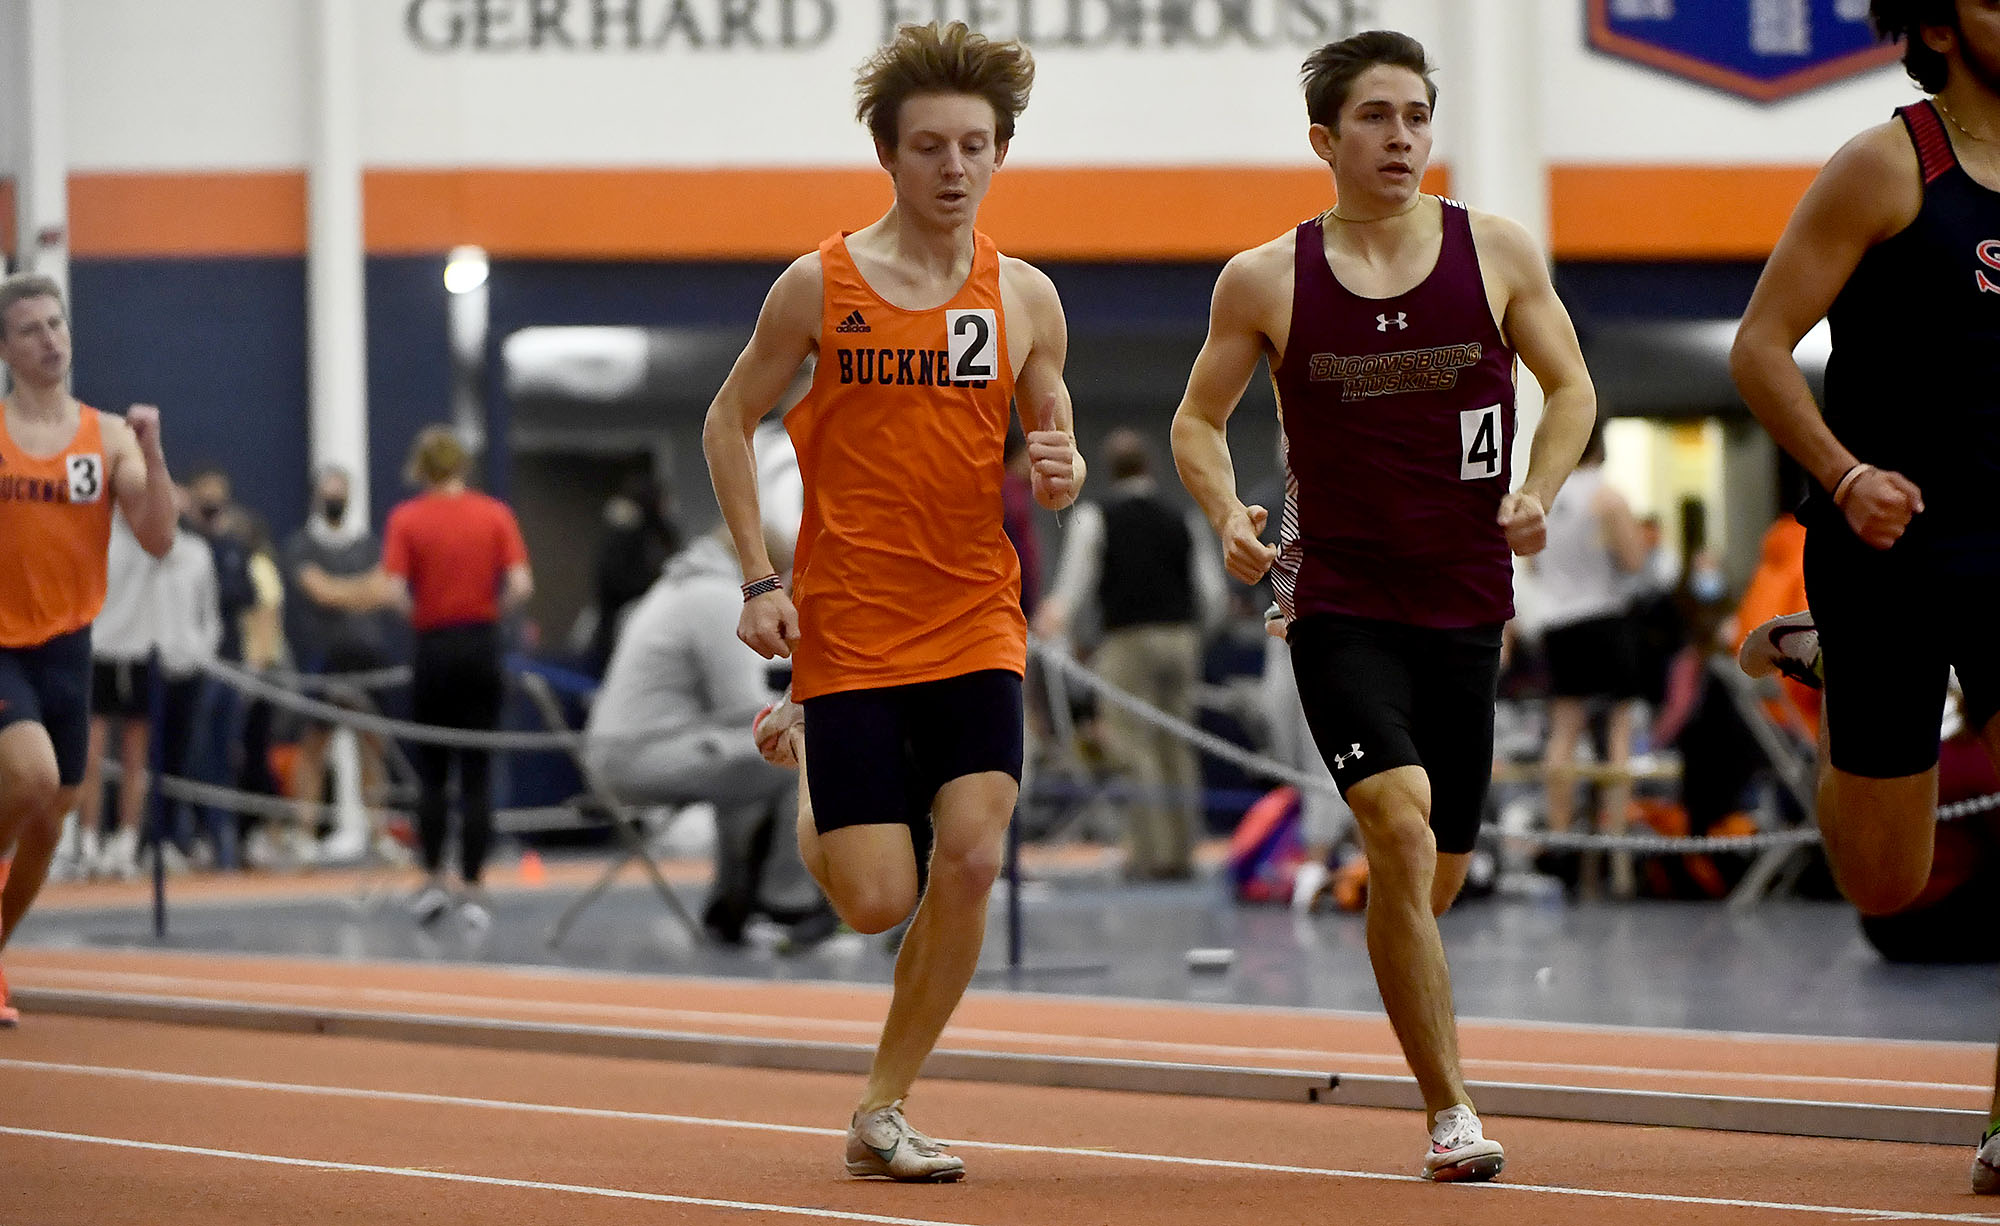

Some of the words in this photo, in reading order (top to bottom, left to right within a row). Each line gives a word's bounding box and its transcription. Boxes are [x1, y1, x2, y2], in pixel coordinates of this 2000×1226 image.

[405, 0, 836, 53] GERHARD
[836, 324, 871, 333] adidas
[954, 314, 991, 376] 2
[837, 349, 988, 389] BUCKNE
[1310, 342, 1482, 381] BLOOMSBURG
[1341, 368, 1457, 402] HUSKIES
[1467, 411, 1498, 474] 4
[73, 458, 98, 496] 3
